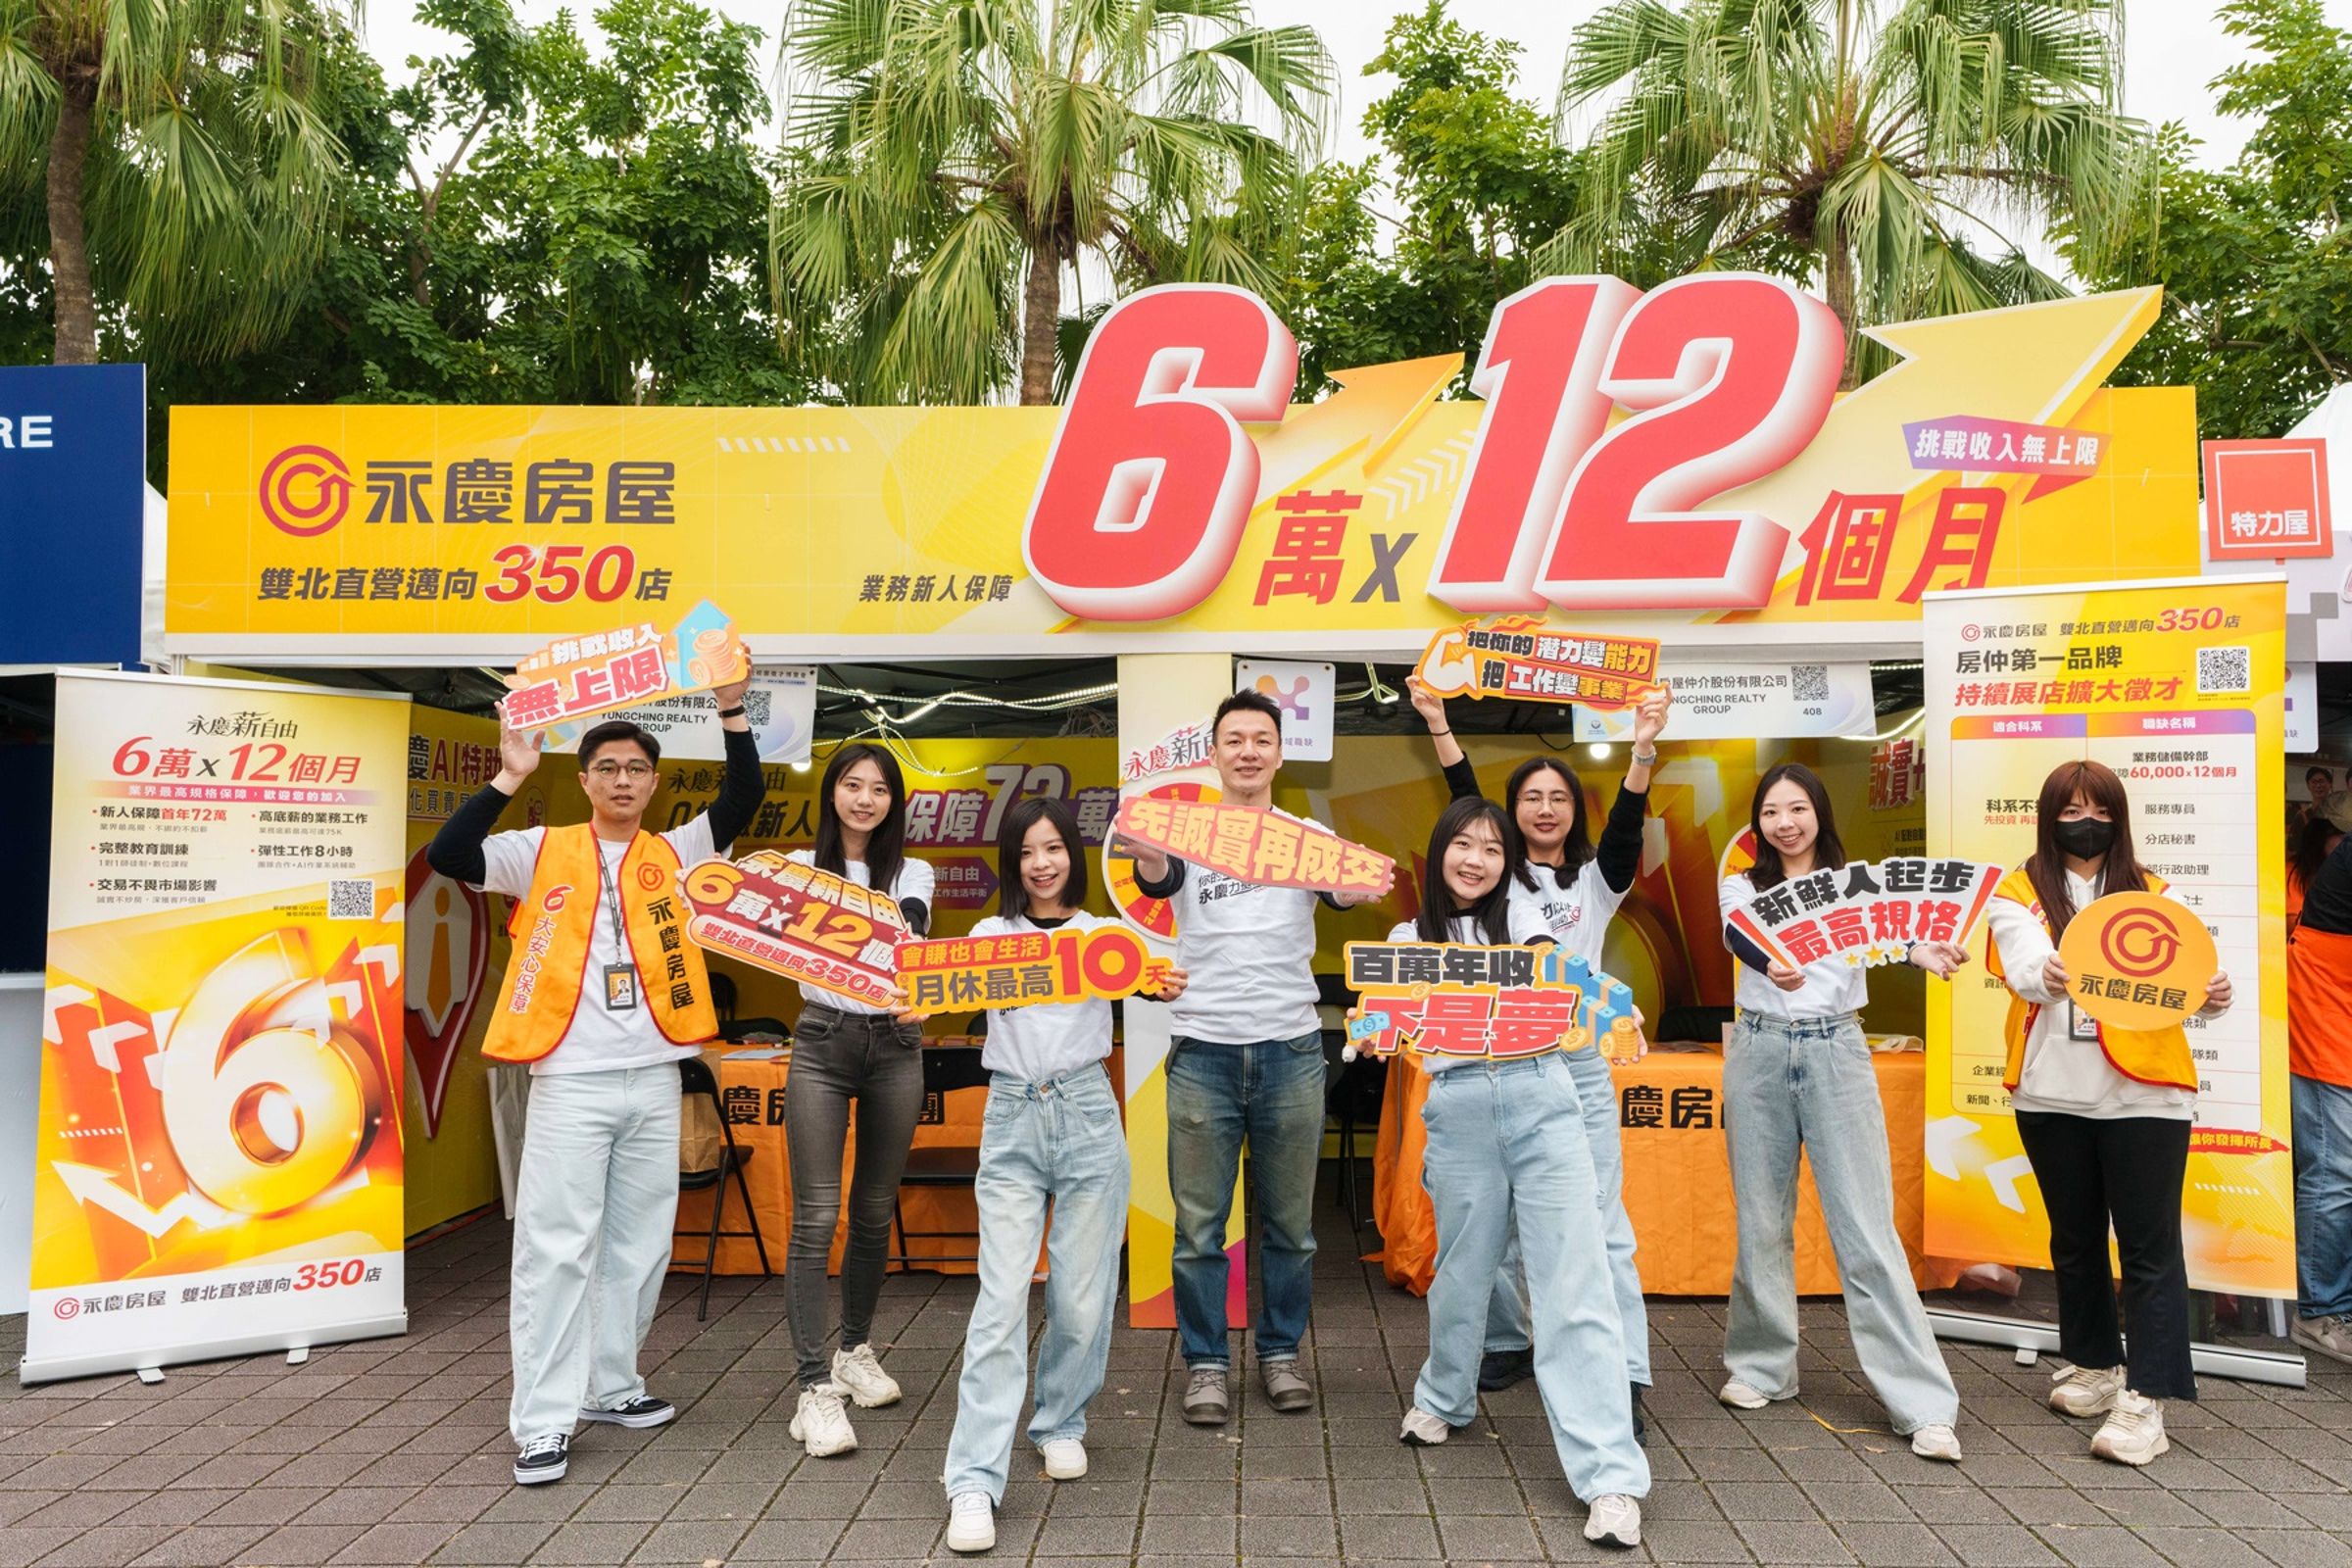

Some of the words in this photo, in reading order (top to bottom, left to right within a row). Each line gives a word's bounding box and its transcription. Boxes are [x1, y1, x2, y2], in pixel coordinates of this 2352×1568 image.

[1913, 428, 2099, 466] 挑戰收入無上限
[365, 458, 675, 525] 永慶房屋
[2230, 510, 2310, 538] 特力屋
[257, 544, 673, 605] 雙北直營邁向350店
[857, 573, 1014, 604] 業務新人保障
[1983, 623, 2047, 638] 永慶房屋
[2059, 607, 2241, 636] 雙北直營邁向350店
[551, 622, 663, 665] 挑戰收入
[1467, 630, 1653, 675] 把你的潛力變能力
[1955, 644, 2124, 674] 房仲第一品牌
[505, 646, 668, 728] 無上限
[1654, 675, 1788, 690] 屋仲介股份有限公司
[1725, 693, 1767, 704] REALTY
[1954, 676, 2184, 708] 持續展店擴大徵才
[186, 710, 299, 740] 永慶薪自由
[601, 710, 664, 722] YUNGCHING
[665, 713, 709, 723] REALTY
[1692, 705, 1732, 714] GROUP
[1802, 708, 1823, 716] 408
[1992, 720, 2043, 734] 適合科系
[2142, 716, 2197, 731] 職缺名稱
[1124, 722, 1213, 778] 永慶薪
[2132, 751, 2209, 763] 業務儲備幹部
[259, 810, 368, 824] 高底薪的業務工作
[1984, 814, 2017, 825] 先投資
[2144, 804, 2196, 815] 服務專員
[99, 842, 189, 856] 完整教育訓練
[258, 845, 354, 858] 彈性工作8小時
[1126, 800, 1385, 888] 先誠實再成交
[2144, 833, 2196, 846] 分店秘書
[97, 878, 218, 892] 交易不畏市場影響
[736, 852, 906, 930] 永慶薪自由
[1749, 860, 1975, 928] 新鮮人起步
[1775, 899, 1963, 967] 最高規格
[647, 896, 695, 1010] 永慶房屋
[700, 921, 890, 1003] 雙北直營邁向350店
[901, 935, 1044, 968] 會賺也會生活
[1348, 946, 1536, 987] 百萬年收
[2080, 973, 2187, 1011] 永慶房屋
[1363, 988, 1576, 1055] 不是夢
[1621, 1085, 1725, 1130] 慶房
[83, 1290, 167, 1314] 永慶房屋
[180, 1258, 382, 1305] 雙北直營邁向350店
